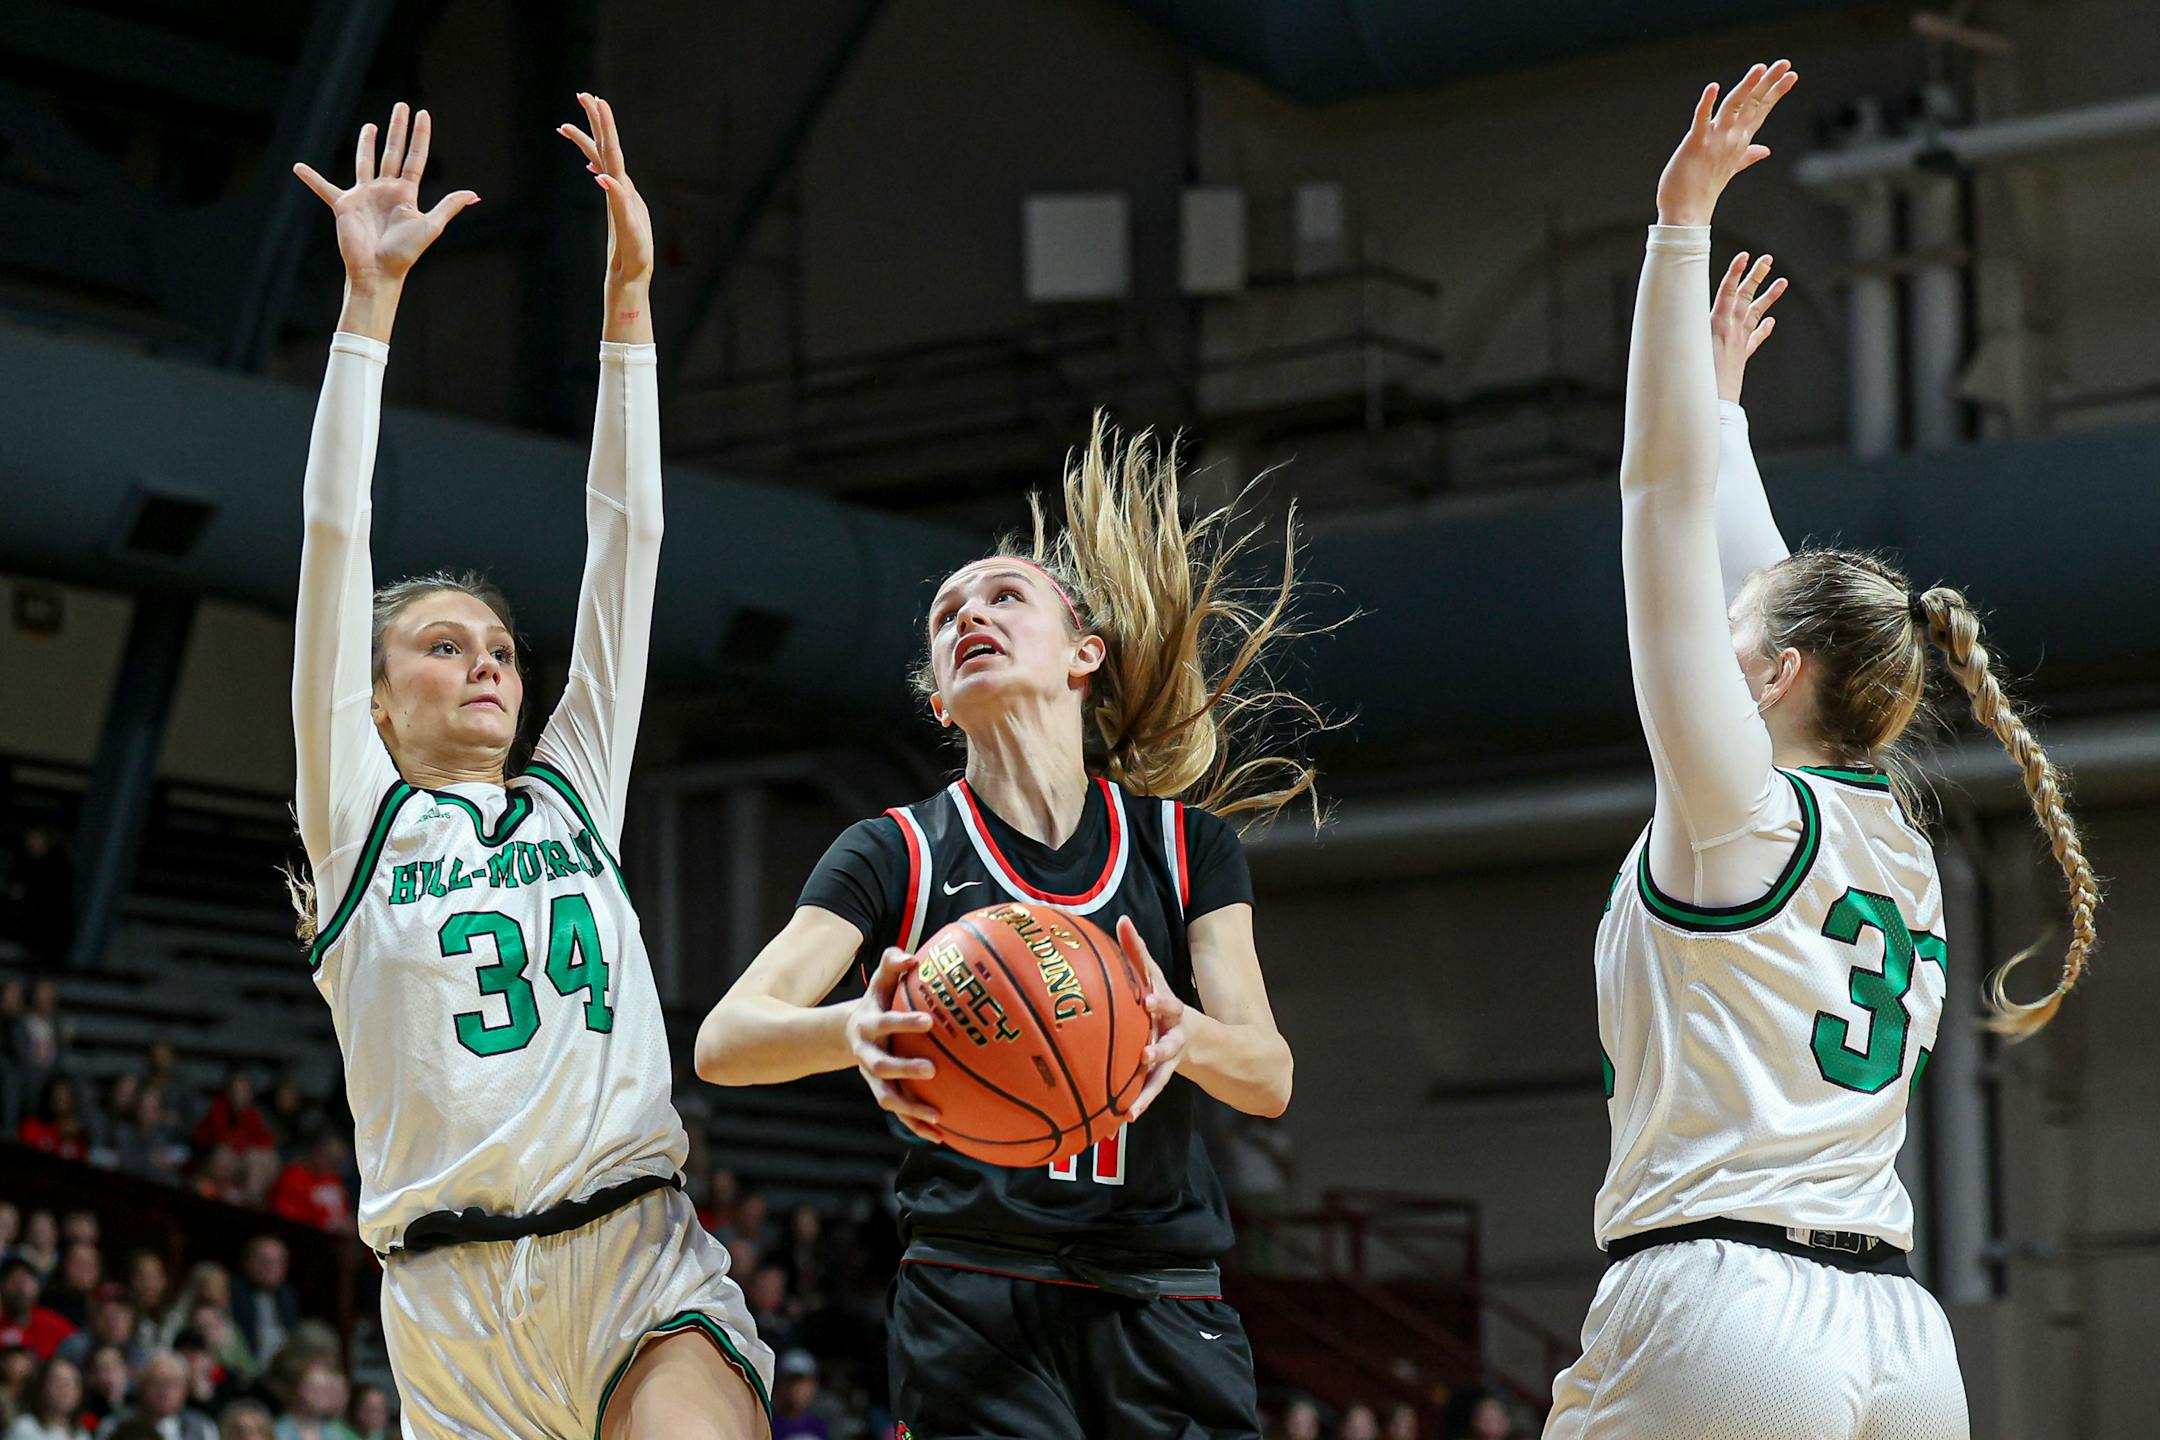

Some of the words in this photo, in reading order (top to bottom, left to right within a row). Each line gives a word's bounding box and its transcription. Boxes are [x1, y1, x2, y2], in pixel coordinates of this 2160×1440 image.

[438, 893, 614, 1058] 34
[928, 931, 1022, 1044] LEGACY
[976, 903, 1093, 1022] SPALDING
